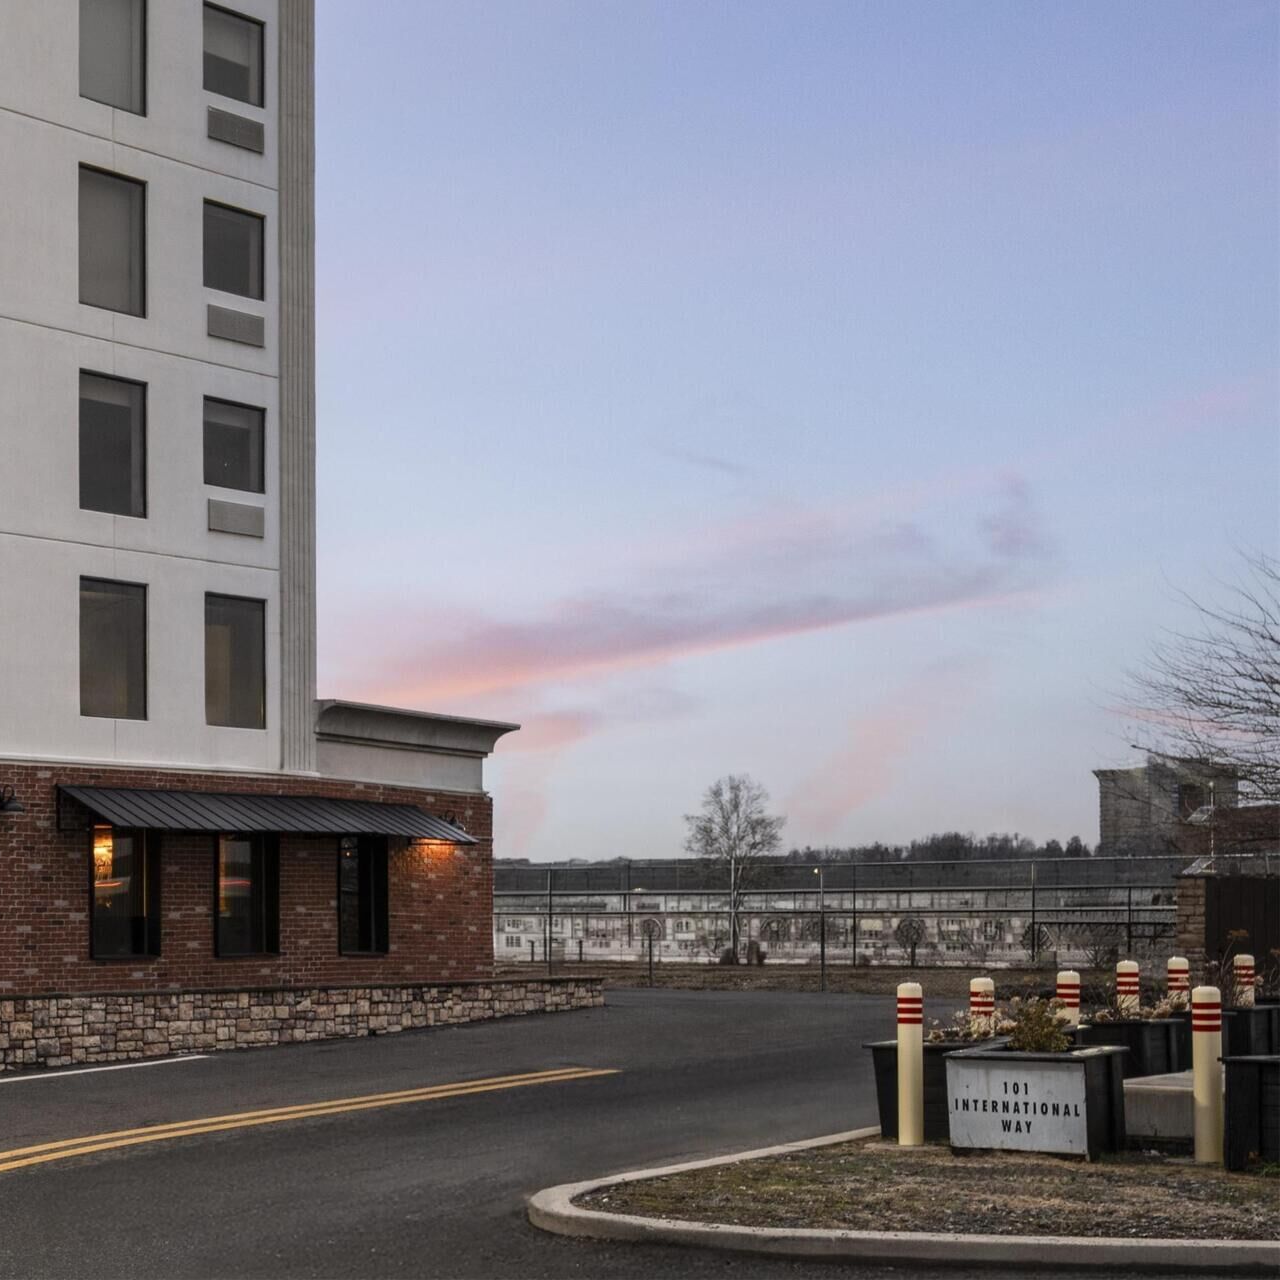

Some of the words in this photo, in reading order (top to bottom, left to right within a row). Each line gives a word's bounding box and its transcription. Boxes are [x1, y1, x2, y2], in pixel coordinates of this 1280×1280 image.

[1003, 1081, 1029, 1095] 101
[955, 1098, 1080, 1117] INTERNATIONAL
[1001, 1119, 1032, 1133] WAY
